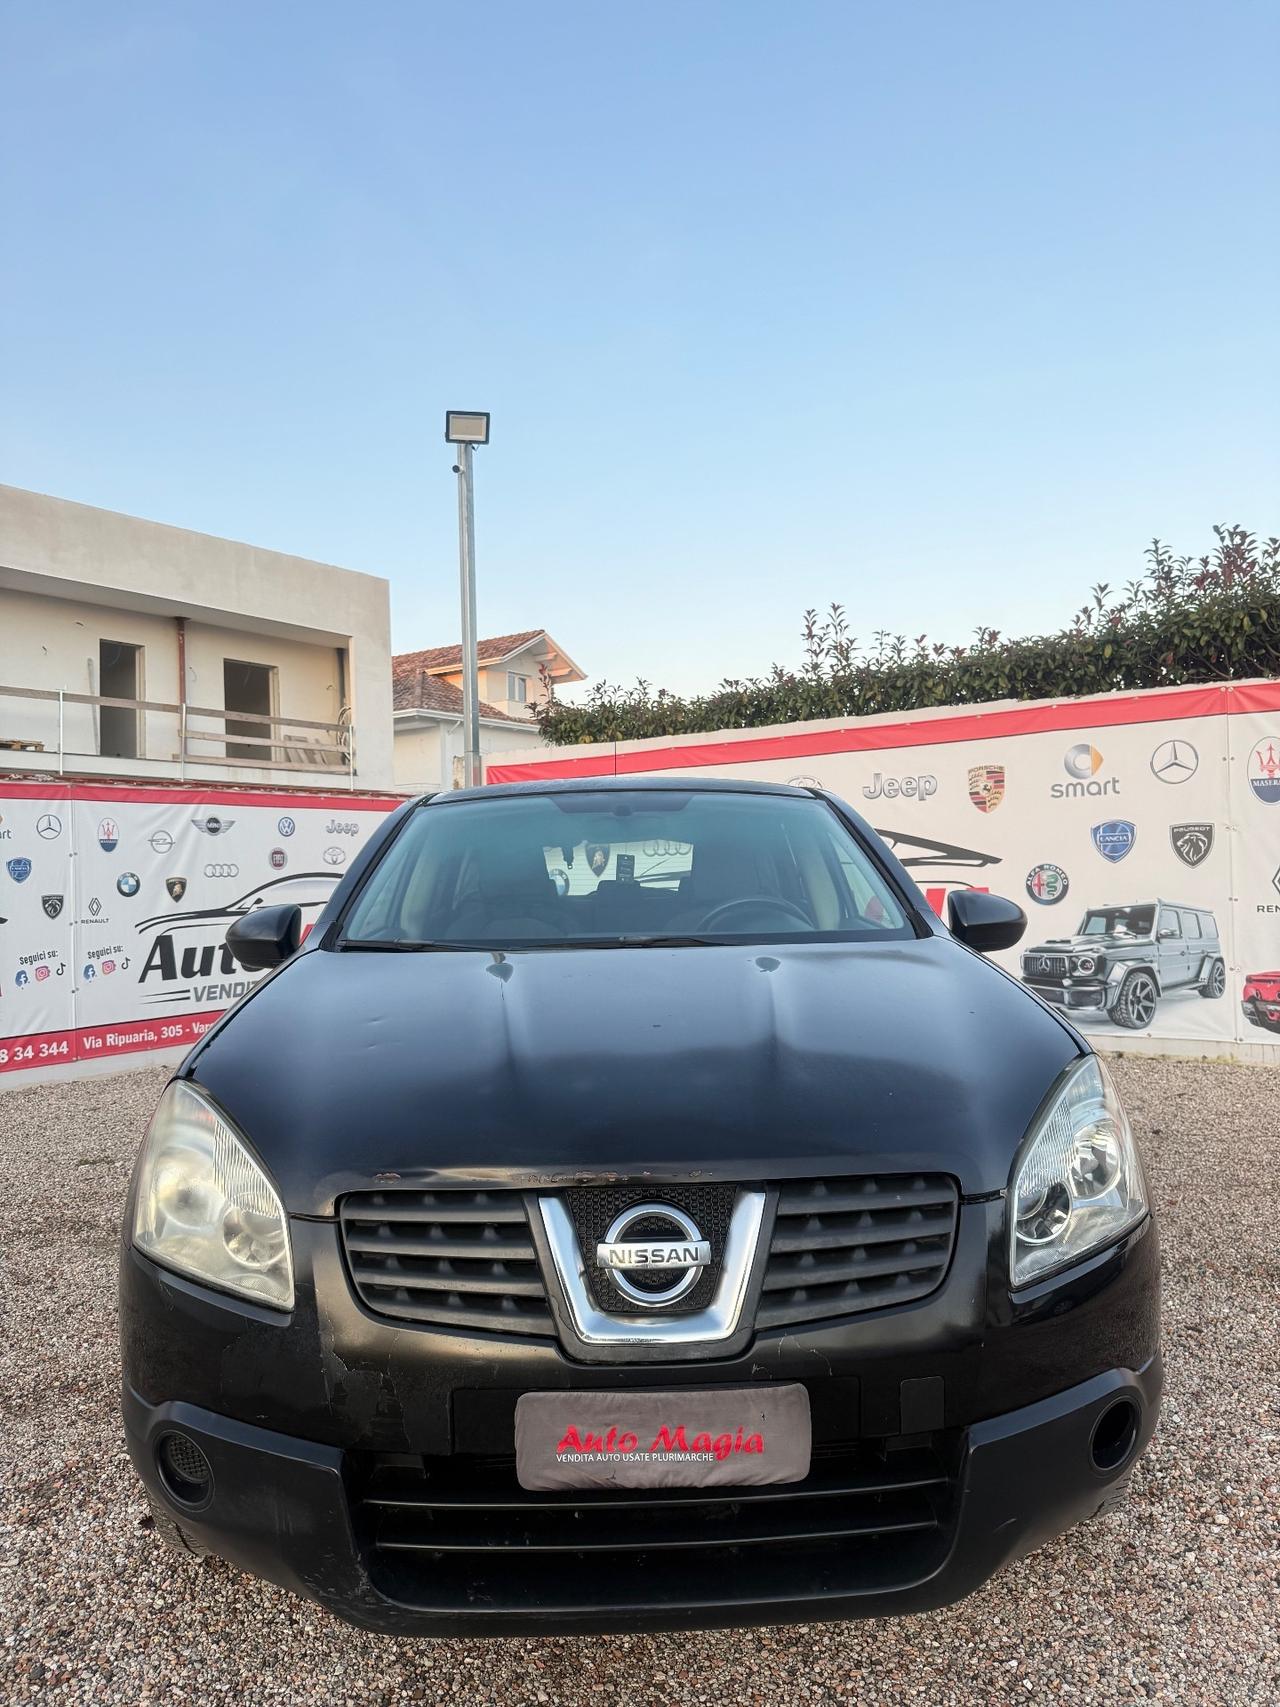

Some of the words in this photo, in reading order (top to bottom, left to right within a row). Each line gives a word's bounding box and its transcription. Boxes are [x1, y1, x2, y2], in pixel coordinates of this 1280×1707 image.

[863, 772, 938, 801] Jeep
[1051, 777, 1120, 799] smart
[326, 820, 359, 836] Jeep
[1026, 868, 1041, 886] ALFA
[1043, 864, 1068, 886] ROMEO
[19, 950, 46, 966] Seguici
[47, 950, 59, 958] su:
[87, 946, 113, 960] Seguici
[113, 945, 124, 954] su:
[138, 934, 265, 984] Aut
[193, 981, 259, 1002] VENDI
[83, 1036, 102, 1050] Via
[106, 1029, 158, 1047] Ripuaria,
[161, 1025, 183, 1039] 305
[13, 1045, 35, 1061] 34
[39, 1041, 69, 1057] 344
[609, 1246, 699, 1265] NISSAN
[556, 1424, 639, 1453] Auto
[648, 1424, 764, 1461] Magia
[556, 1453, 595, 1463] VENDITA
[596, 1453, 621, 1462] AUTO
[622, 1452, 650, 1462] USATE
[652, 1452, 714, 1462] PLURIMARCHE
